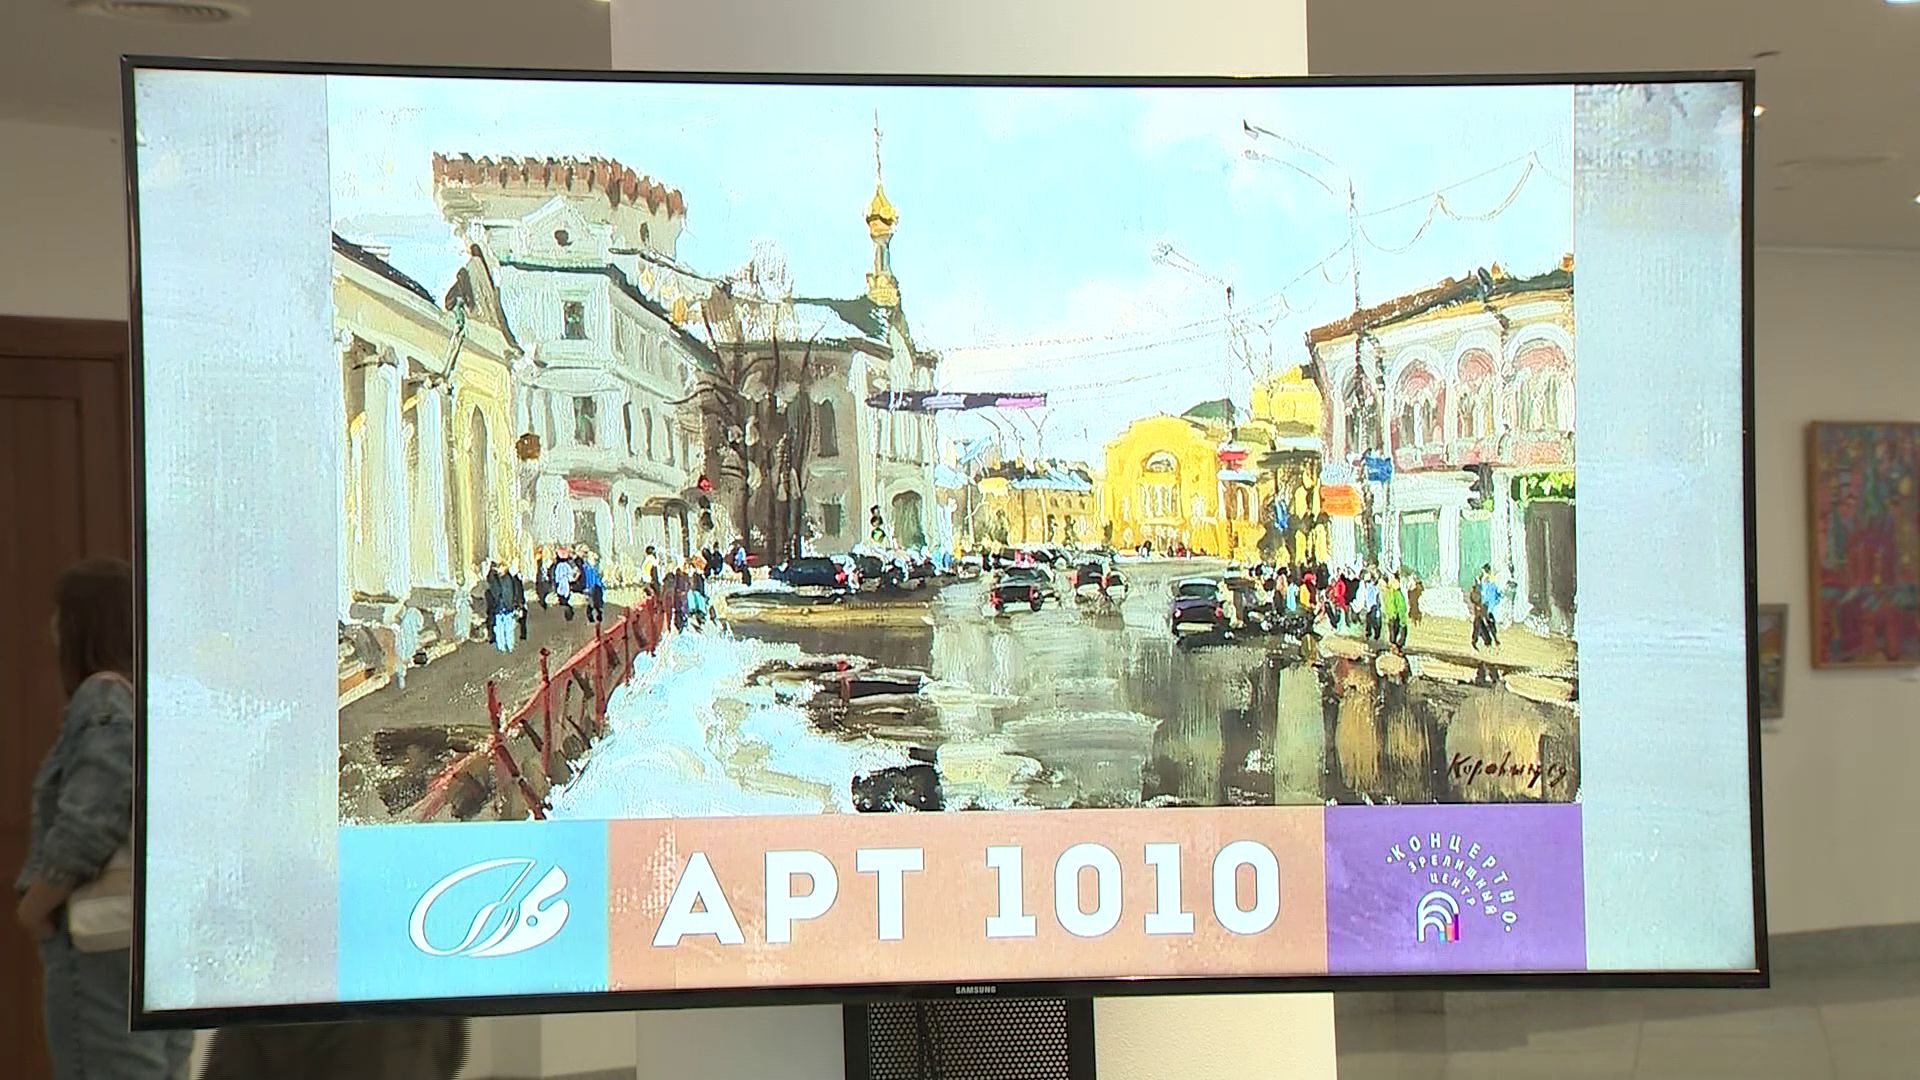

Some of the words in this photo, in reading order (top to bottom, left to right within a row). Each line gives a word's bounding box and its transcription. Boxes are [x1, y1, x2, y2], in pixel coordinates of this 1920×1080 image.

[651, 848, 924, 947] АРТ
[985, 840, 1281, 938] 1010
[1407, 854, 1498, 915] ЗРЕЛИЩНЫЙ
[1429, 872, 1476, 906] ЦЕНТР
[955, 985, 997, 995] SAMSUNG
